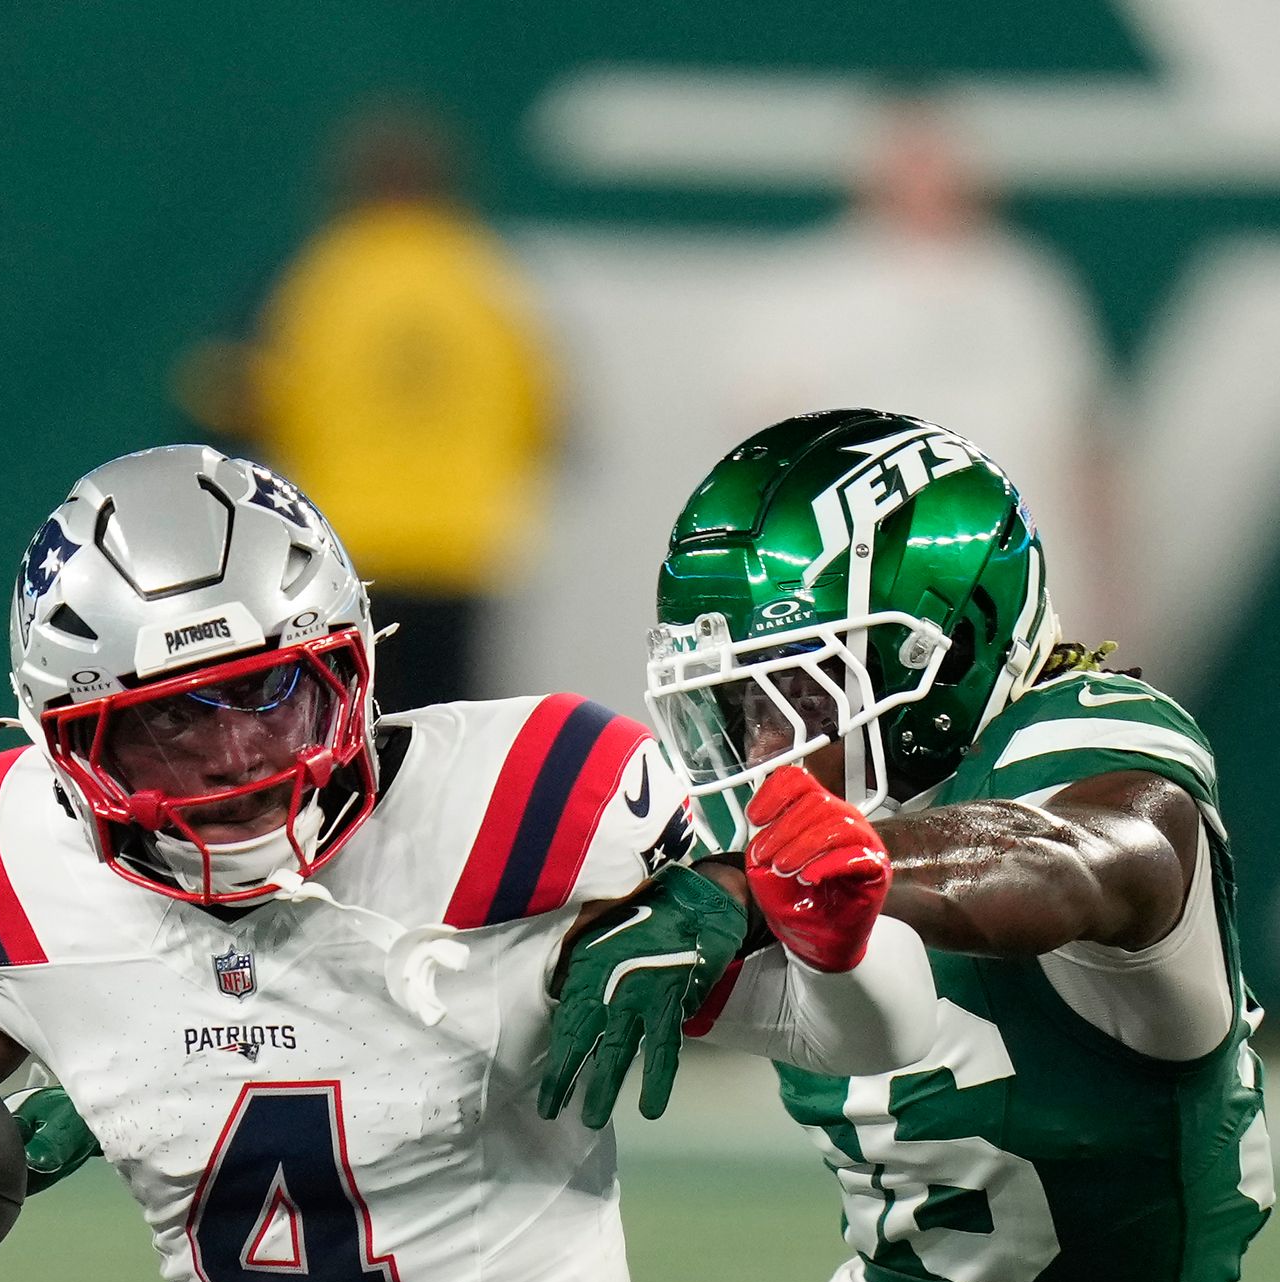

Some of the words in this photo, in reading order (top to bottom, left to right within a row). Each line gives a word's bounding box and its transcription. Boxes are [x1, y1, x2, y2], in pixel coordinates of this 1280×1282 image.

[803, 427, 978, 588] JETS
[287, 622, 326, 641] OAKLEY
[756, 611, 812, 631] OAKLEY
[165, 617, 231, 655] PATRIOTS
[69, 682, 112, 693] OAKLEY
[222, 971, 251, 992] NFL
[184, 1025, 297, 1055] PATRIOTS
